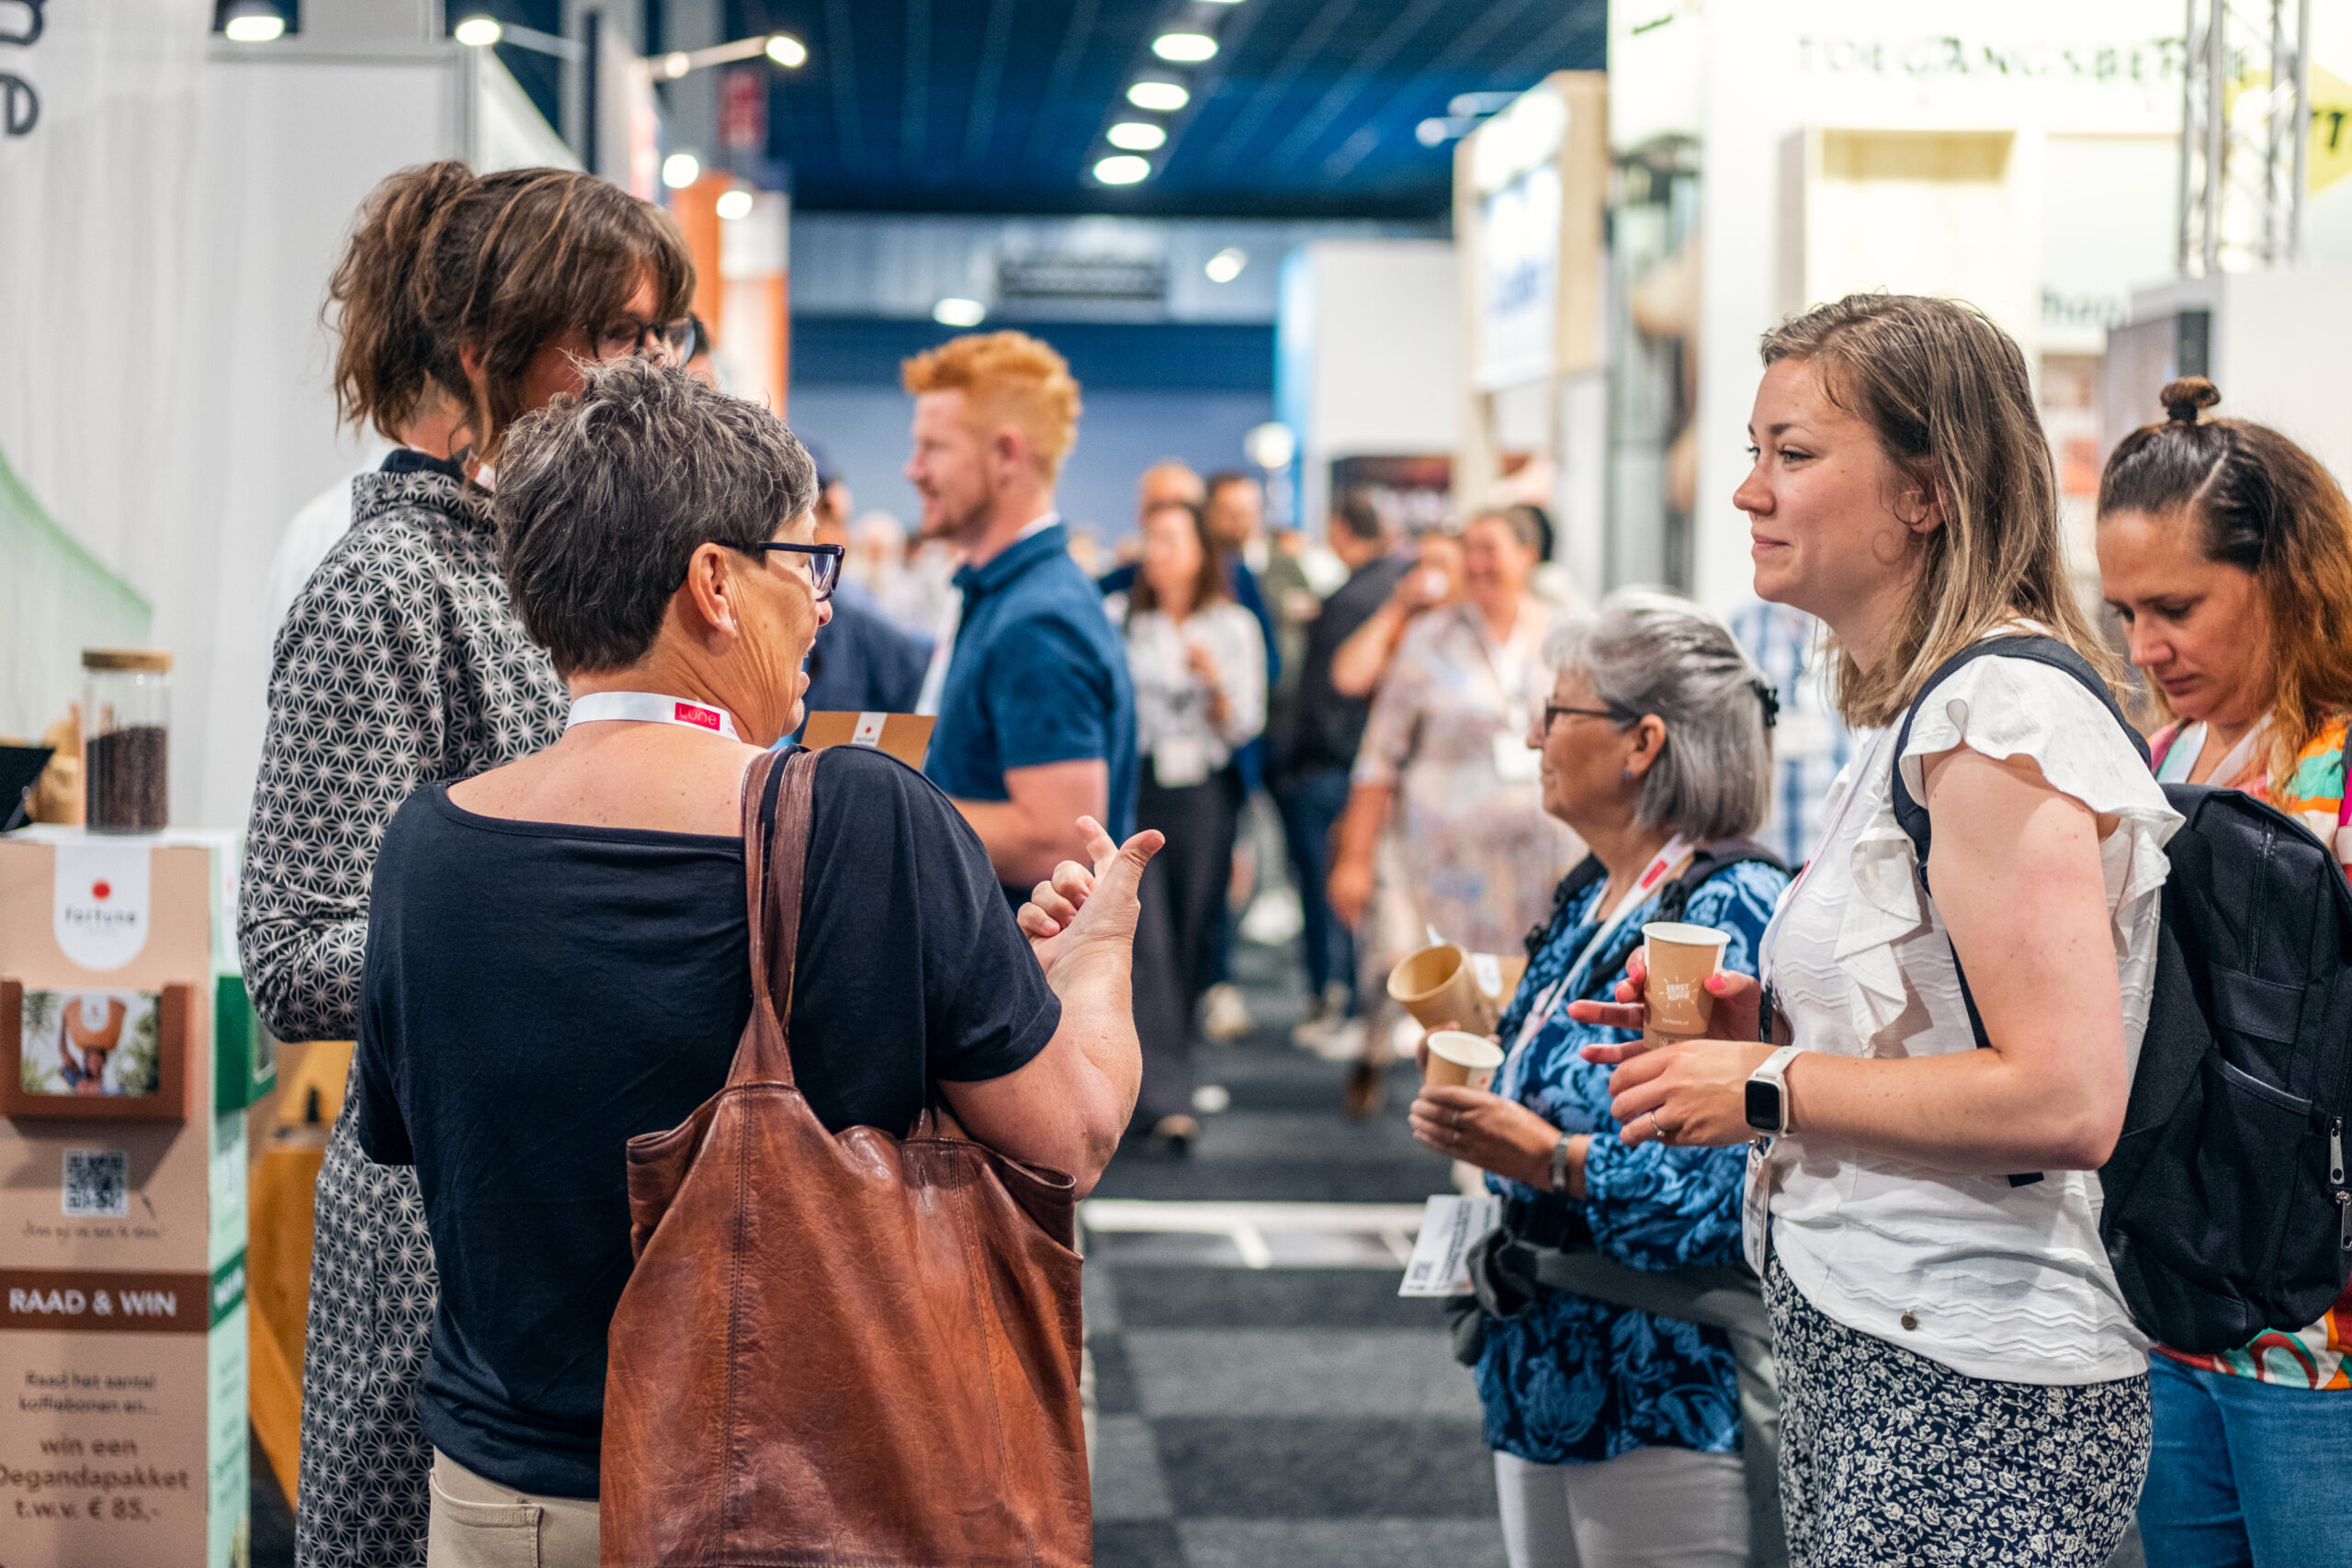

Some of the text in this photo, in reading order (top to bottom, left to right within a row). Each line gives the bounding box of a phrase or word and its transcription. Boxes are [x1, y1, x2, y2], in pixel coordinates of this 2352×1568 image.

[8, 1288, 177, 1317] RAAD & WIN
[40, 1433, 137, 1457] win een
[87, 1496, 103, 1519] €
